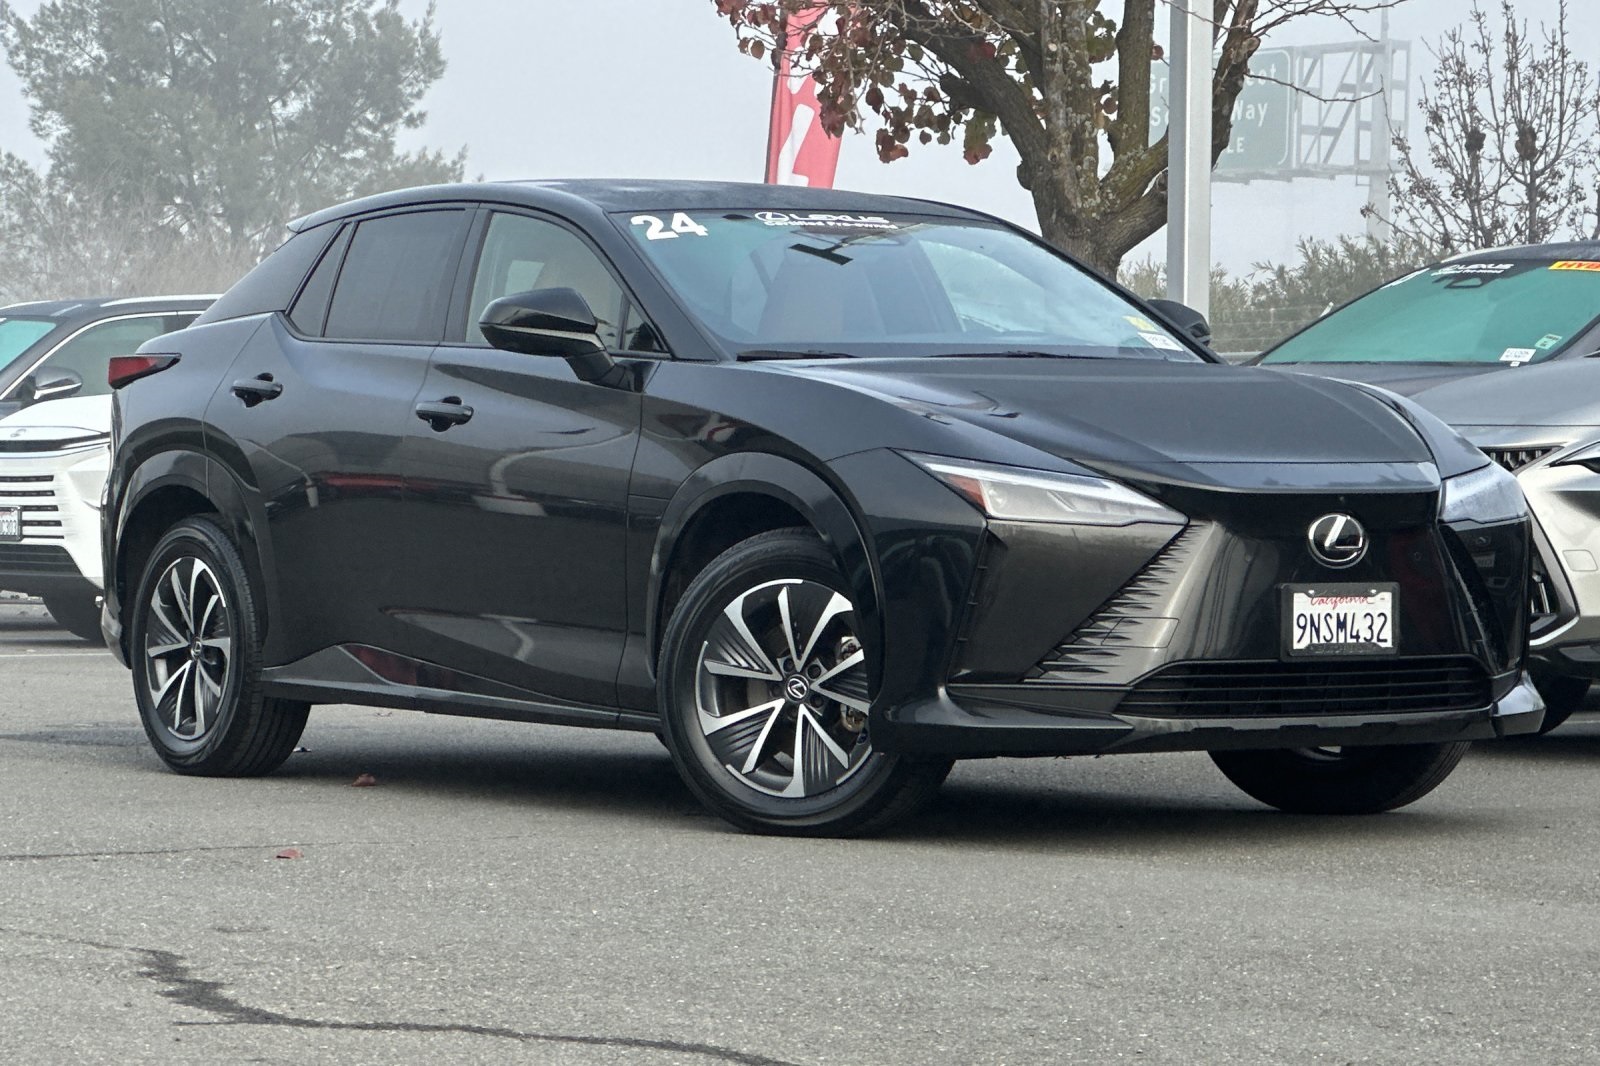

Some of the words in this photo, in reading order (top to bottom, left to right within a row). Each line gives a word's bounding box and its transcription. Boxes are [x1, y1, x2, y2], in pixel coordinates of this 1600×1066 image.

[631, 212, 708, 240] 24
[1557, 261, 1600, 270] HYB
[1296, 612, 1388, 643] 9NSM432
